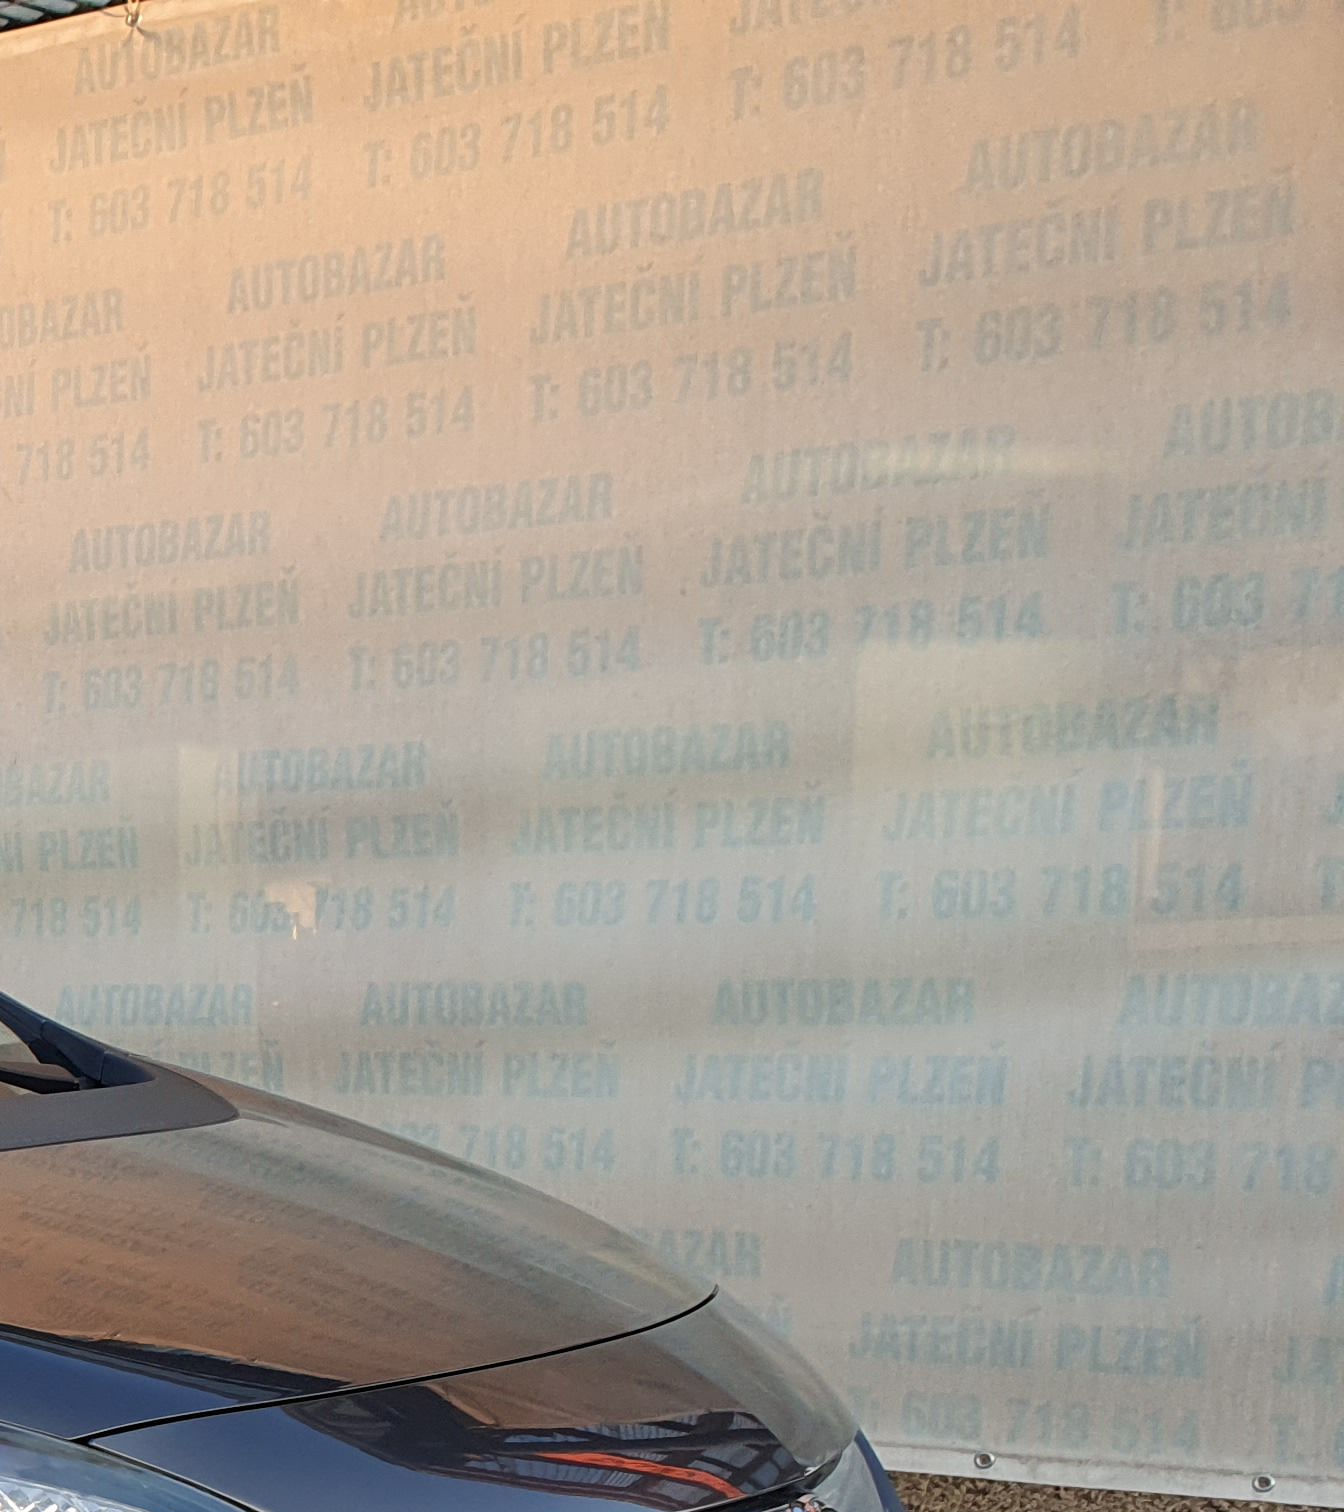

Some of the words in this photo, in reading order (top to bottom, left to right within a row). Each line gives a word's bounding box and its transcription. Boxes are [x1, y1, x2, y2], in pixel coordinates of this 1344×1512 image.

[362, 14, 526, 110] JATEČNÍ
[204, 61, 314, 143] PLZEŇ
[363, 138, 393, 189] T:
[409, 121, 481, 181] 603
[500, 103, 573, 164] 718
[591, 83, 668, 146] 514
[962, 91, 1266, 195] AUTOBAZAR
[88, 183, 150, 239] 603
[167, 168, 230, 224] 718
[245, 153, 311, 211] 514
[565, 166, 824, 258] AUTOBAZAR
[918, 187, 1124, 286] JATEČNÍ
[1139, 160, 1301, 256] PLZEŇ
[225, 232, 447, 314] AUTOBAZAR
[530, 254, 704, 343] JATEČNÍ
[721, 230, 858, 316] PLZEŇ
[197, 310, 347, 392] JATEČNÍ
[361, 290, 478, 369] PLZEŇ
[972, 301, 1063, 365] 603
[1087, 286, 1178, 350] 718
[51, 340, 152, 412] PLZEŇ
[529, 372, 561, 422] T:
[577, 359, 654, 417] 603
[675, 346, 752, 404] 718
[770, 330, 852, 391] 514
[16, 436, 75, 486] 718
[88, 426, 149, 478] 514
[196, 418, 224, 464] T:
[239, 406, 305, 460] 603
[321, 396, 388, 450] 718
[404, 383, 474, 439] 514
[379, 470, 614, 542] AUTOBAZAR
[700, 504, 886, 586] JATEČNÍ
[904, 488, 1050, 569] PLZEŇ
[69, 508, 272, 574] AUTOBAZAR
[347, 544, 506, 619] JATEČNÍ
[520, 530, 644, 604] PLZEŇ
[42, 576, 180, 645] JATEČNÍ
[193, 564, 300, 632] PLZEŇ
[750, 607, 831, 662] 603
[954, 588, 1041, 646] 514
[1110, 580, 1149, 634] T:
[42, 671, 67, 714] T:
[82, 664, 142, 711] 603
[158, 658, 220, 705] 718
[234, 651, 298, 700] 514
[391, 638, 461, 689] 603
[479, 631, 549, 682] 718
[566, 623, 640, 677] 514
[541, 719, 791, 780] AUTOBAZAR
[926, 691, 1219, 759] AUTOBAZAR
[212, 740, 427, 796] AUTOBAZAR
[882, 767, 1080, 841] JATEČNÍ
[1099, 757, 1254, 832] PLZEŇ
[40, 813, 138, 871] PLZEŇ
[346, 797, 459, 860] PLZEŇ
[510, 786, 679, 854] JATEČNÍ
[694, 780, 826, 848] PLZEŇ
[10, 896, 67, 938] 718
[81, 894, 140, 937] 514
[186, 891, 213, 934] T:
[387, 884, 455, 931] 514
[552, 879, 627, 927] 603
[645, 877, 720, 925] 718
[736, 874, 815, 924] 514
[876, 871, 911, 920] T:
[930, 867, 1017, 920] 603
[1041, 863, 1128, 916] 718
[1151, 859, 1244, 914] 514
[360, 980, 588, 1025] AUTOBAZAR
[711, 976, 976, 1025] AUTOBAZAR
[333, 1037, 487, 1095] JATEČNÍ
[502, 1038, 622, 1098] PLZEŇ
[673, 1040, 852, 1103] JATEČNÍ
[868, 1040, 1008, 1105] PLZEŇ
[1069, 1041, 1280, 1109] JATEČNÍ
[542, 1126, 614, 1172] 514
[670, 1129, 702, 1175] T:
[718, 1130, 797, 1179] 603
[818, 1133, 897, 1182] 718
[915, 1135, 999, 1184] 514
[890, 1237, 1172, 1298] AUTOBAZAR
[848, 1302, 1039, 1369] JATEČNÍ
[1056, 1313, 1206, 1380] PLZEŇ
[1109, 1404, 1199, 1457] 514
